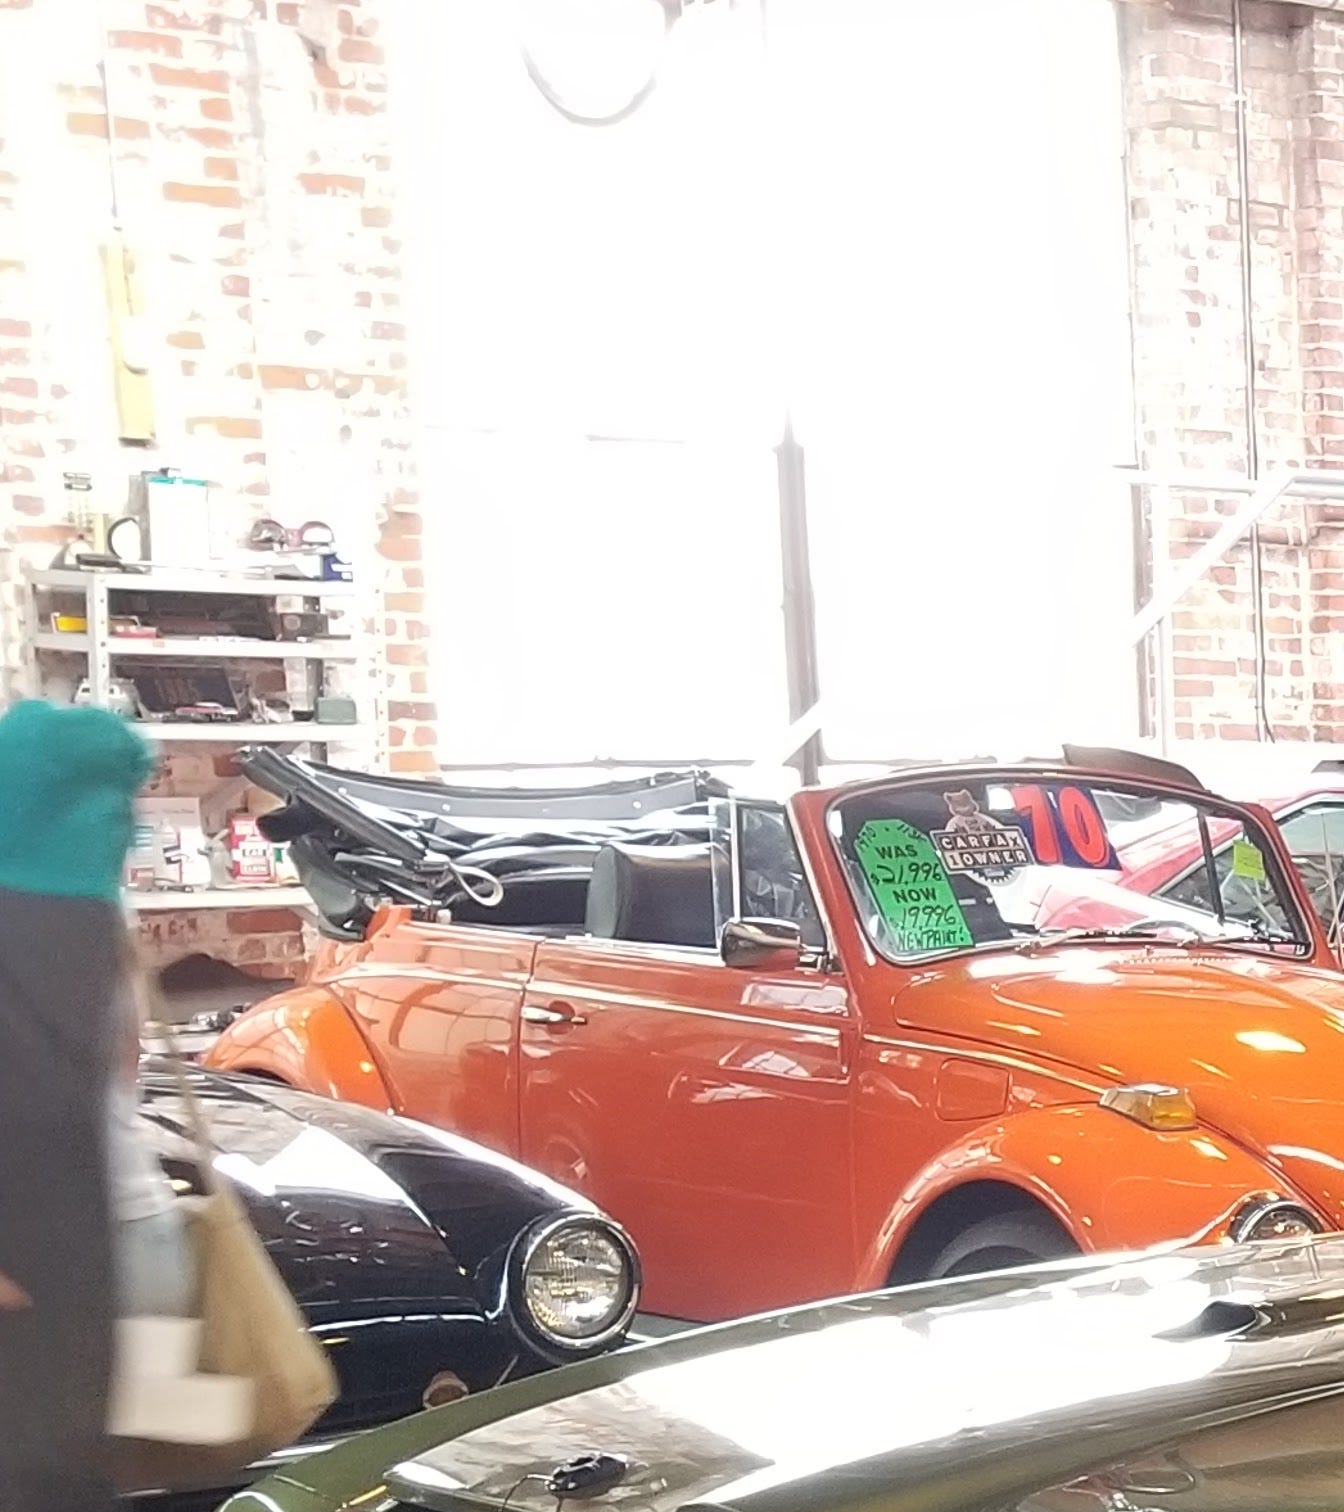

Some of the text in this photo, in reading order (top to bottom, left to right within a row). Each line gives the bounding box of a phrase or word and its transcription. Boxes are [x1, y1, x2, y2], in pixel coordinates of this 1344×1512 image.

[1010, 784, 1111, 868] 70
[941, 831, 1021, 850] CARFAX
[875, 844, 918, 859] WAS
[963, 849, 1028, 866] OWNER
[892, 887, 937, 904] NOW
